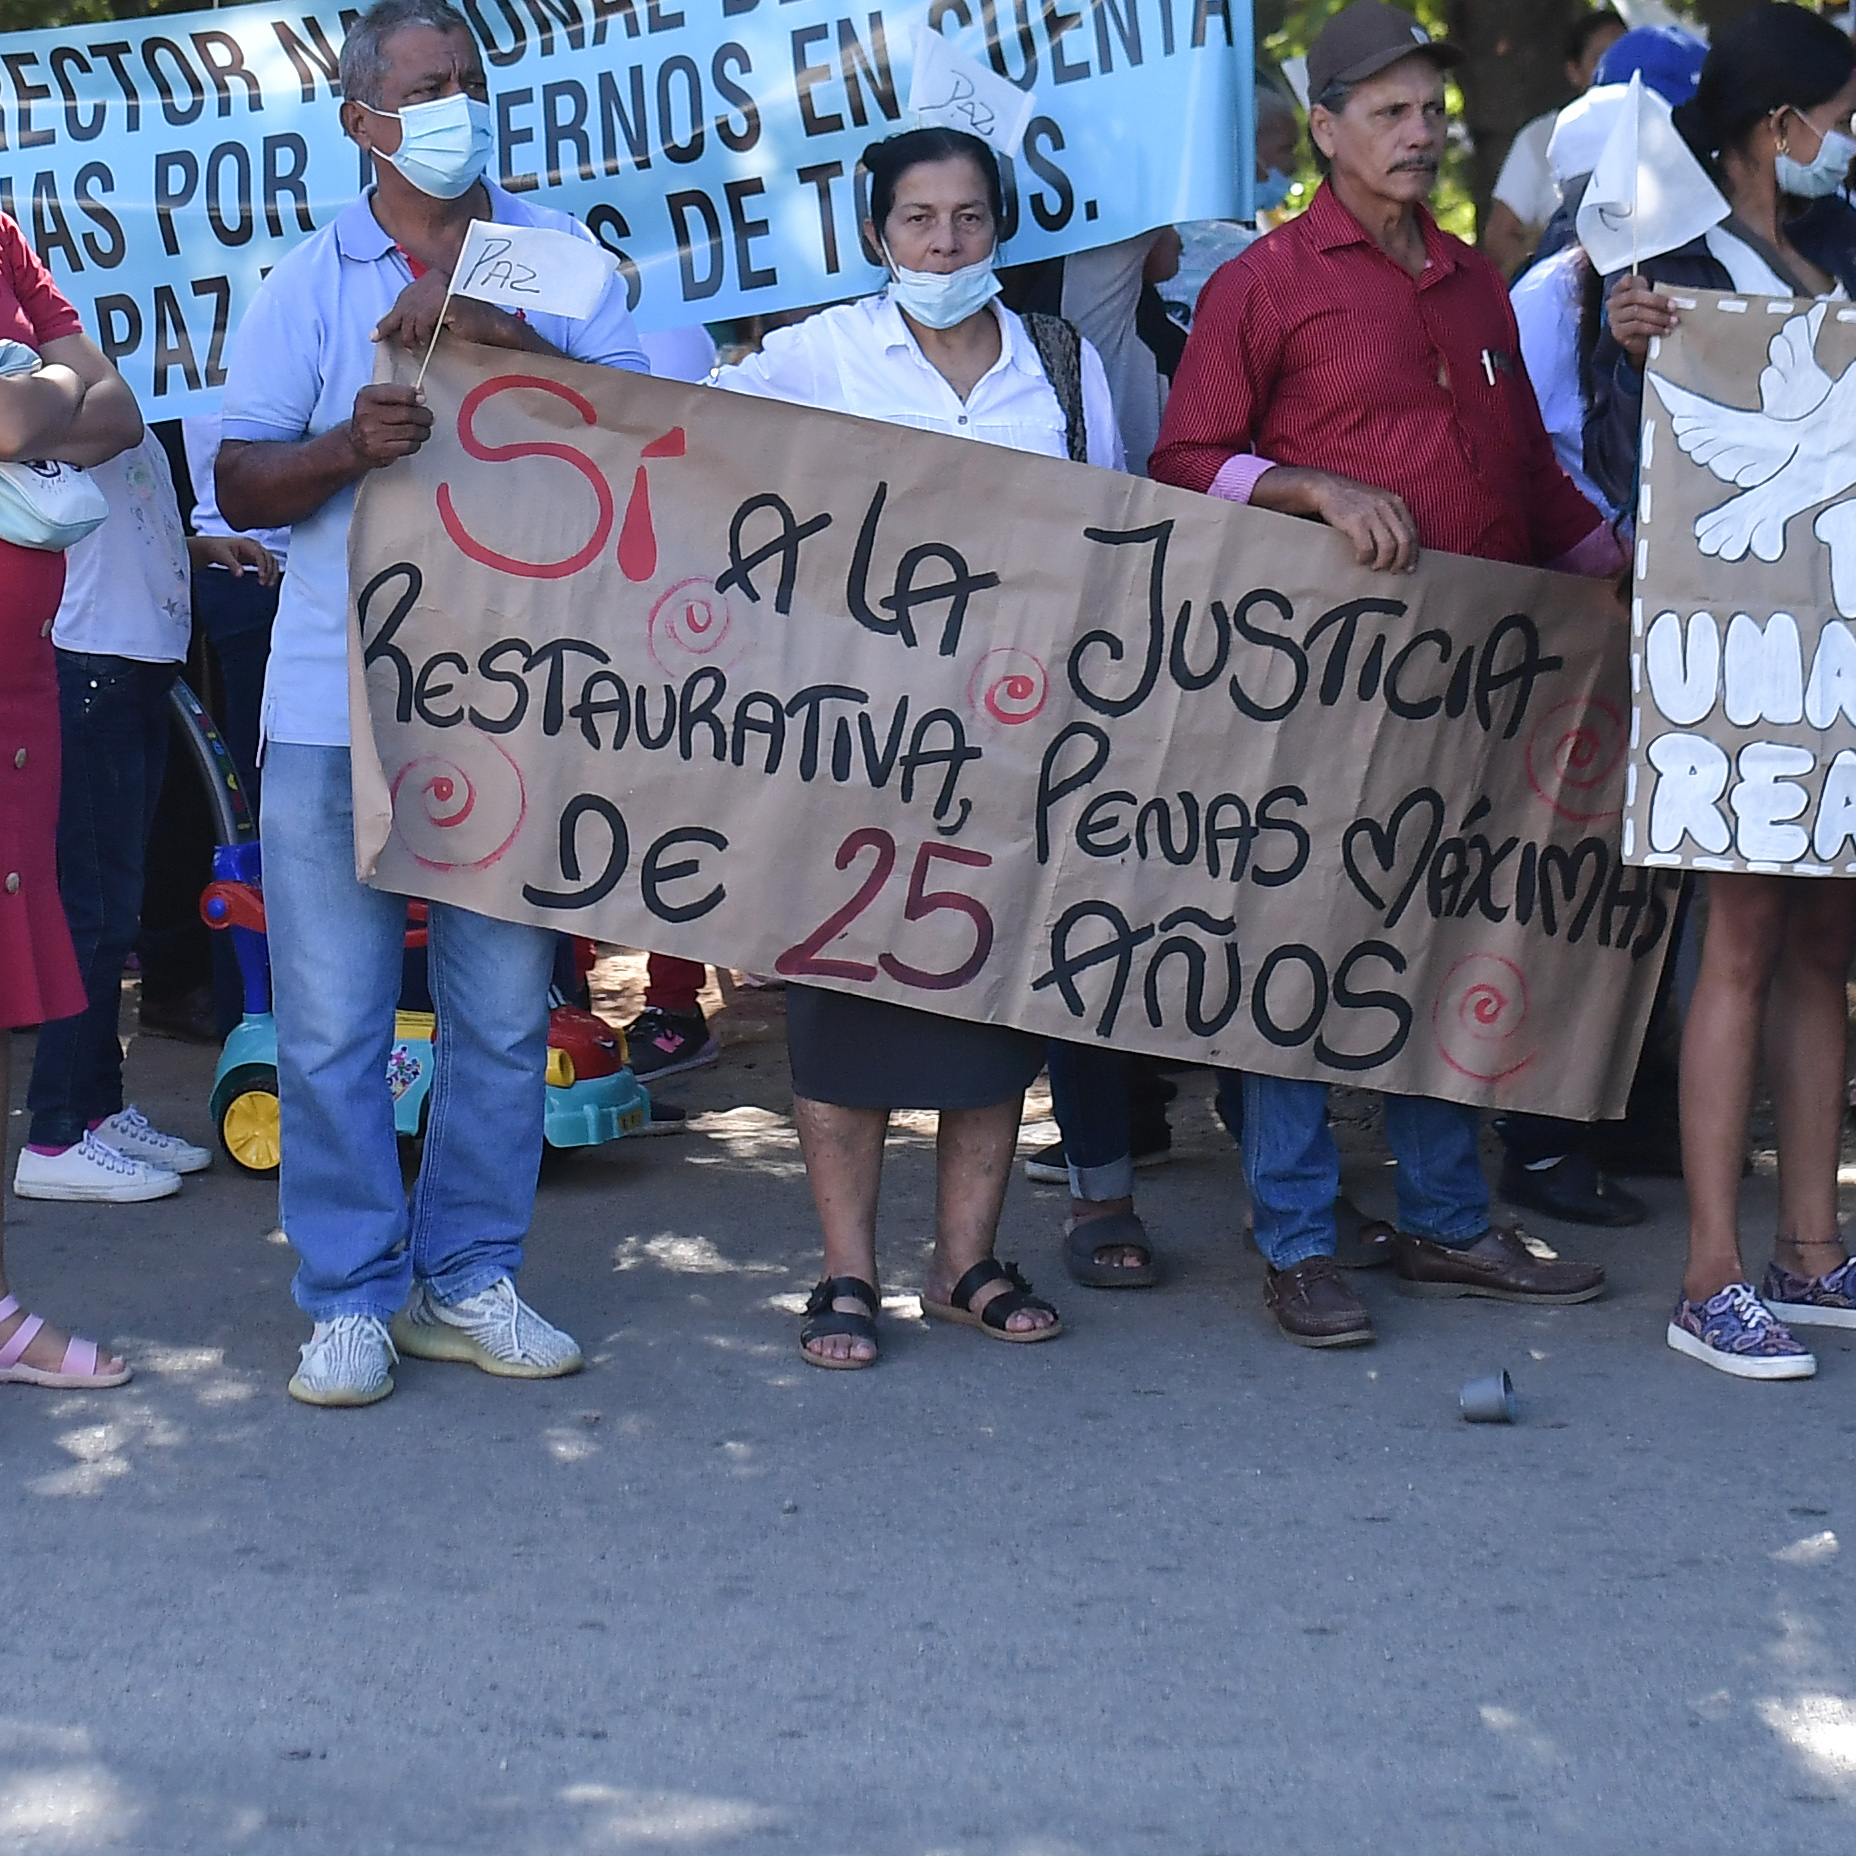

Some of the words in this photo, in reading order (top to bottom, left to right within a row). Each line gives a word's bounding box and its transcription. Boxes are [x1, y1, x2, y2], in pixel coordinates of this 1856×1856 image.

[154, 133, 317, 258] POR
[790, 10, 901, 138] EN
[94, 275, 232, 399] PAZ
[667, 176, 779, 303] DE
[463, 238, 541, 294] PAZ
[357, 561, 983, 836] RESTAURATIVA,
[1035, 720, 1311, 889] PENAS
[714, 491, 833, 617] A
[846, 480, 1001, 657] LA
[1066, 518, 1564, 740] JUSTICIA
[522, 792, 730, 924] DE
[773, 827, 996, 991] 25
[1031, 898, 1414, 1072] AÑOS
